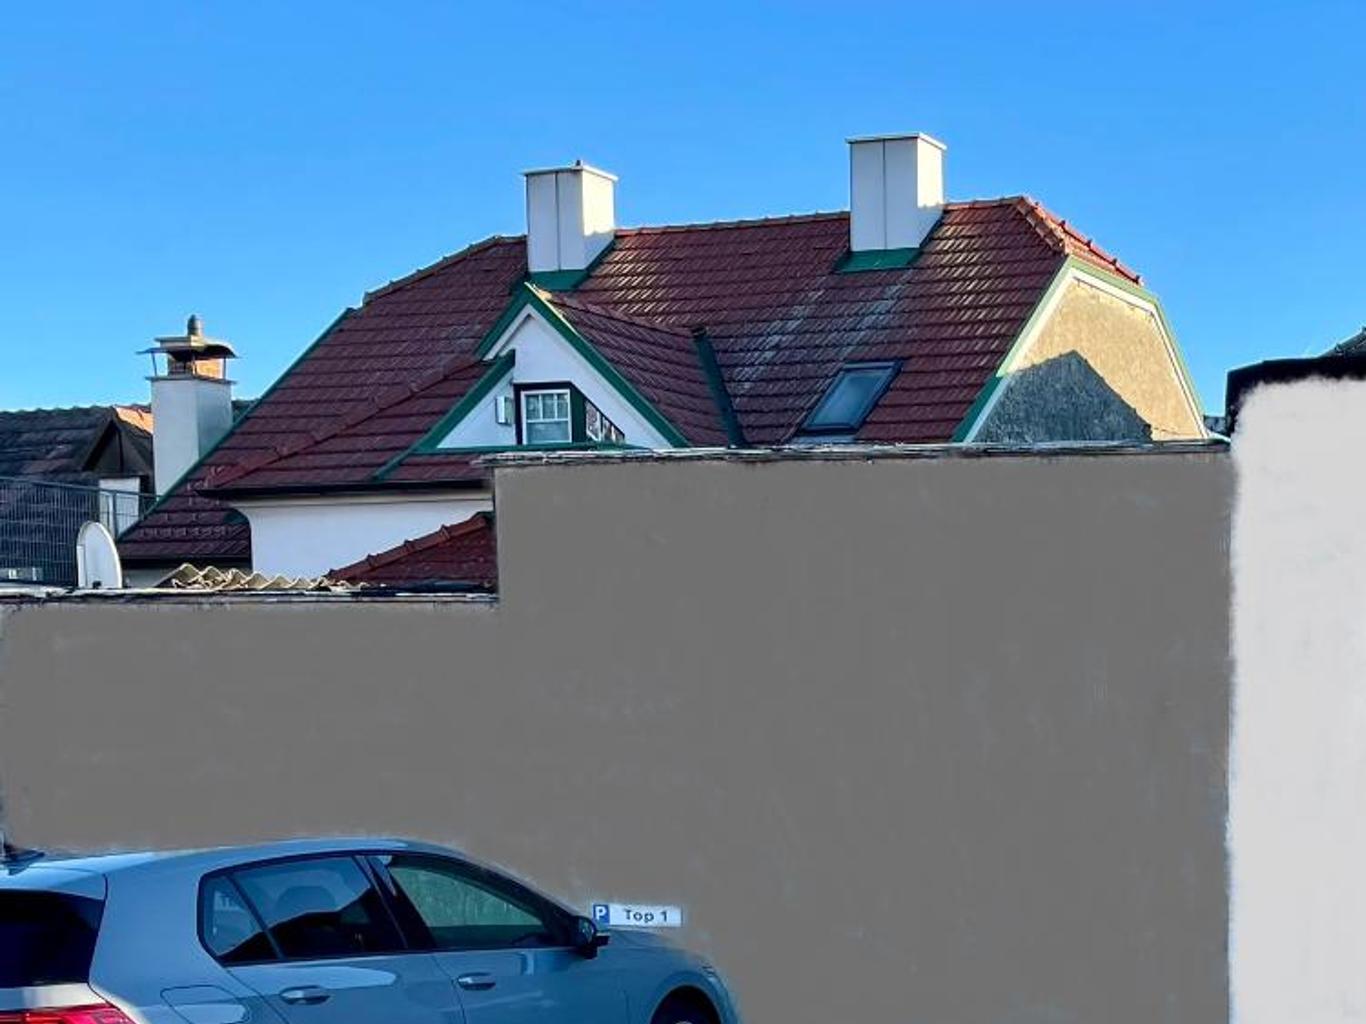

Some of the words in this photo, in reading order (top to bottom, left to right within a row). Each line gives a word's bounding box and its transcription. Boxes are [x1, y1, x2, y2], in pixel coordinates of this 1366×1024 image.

[595, 906, 607, 921] P
[624, 909, 654, 923] Top
[660, 911, 668, 922] 1
